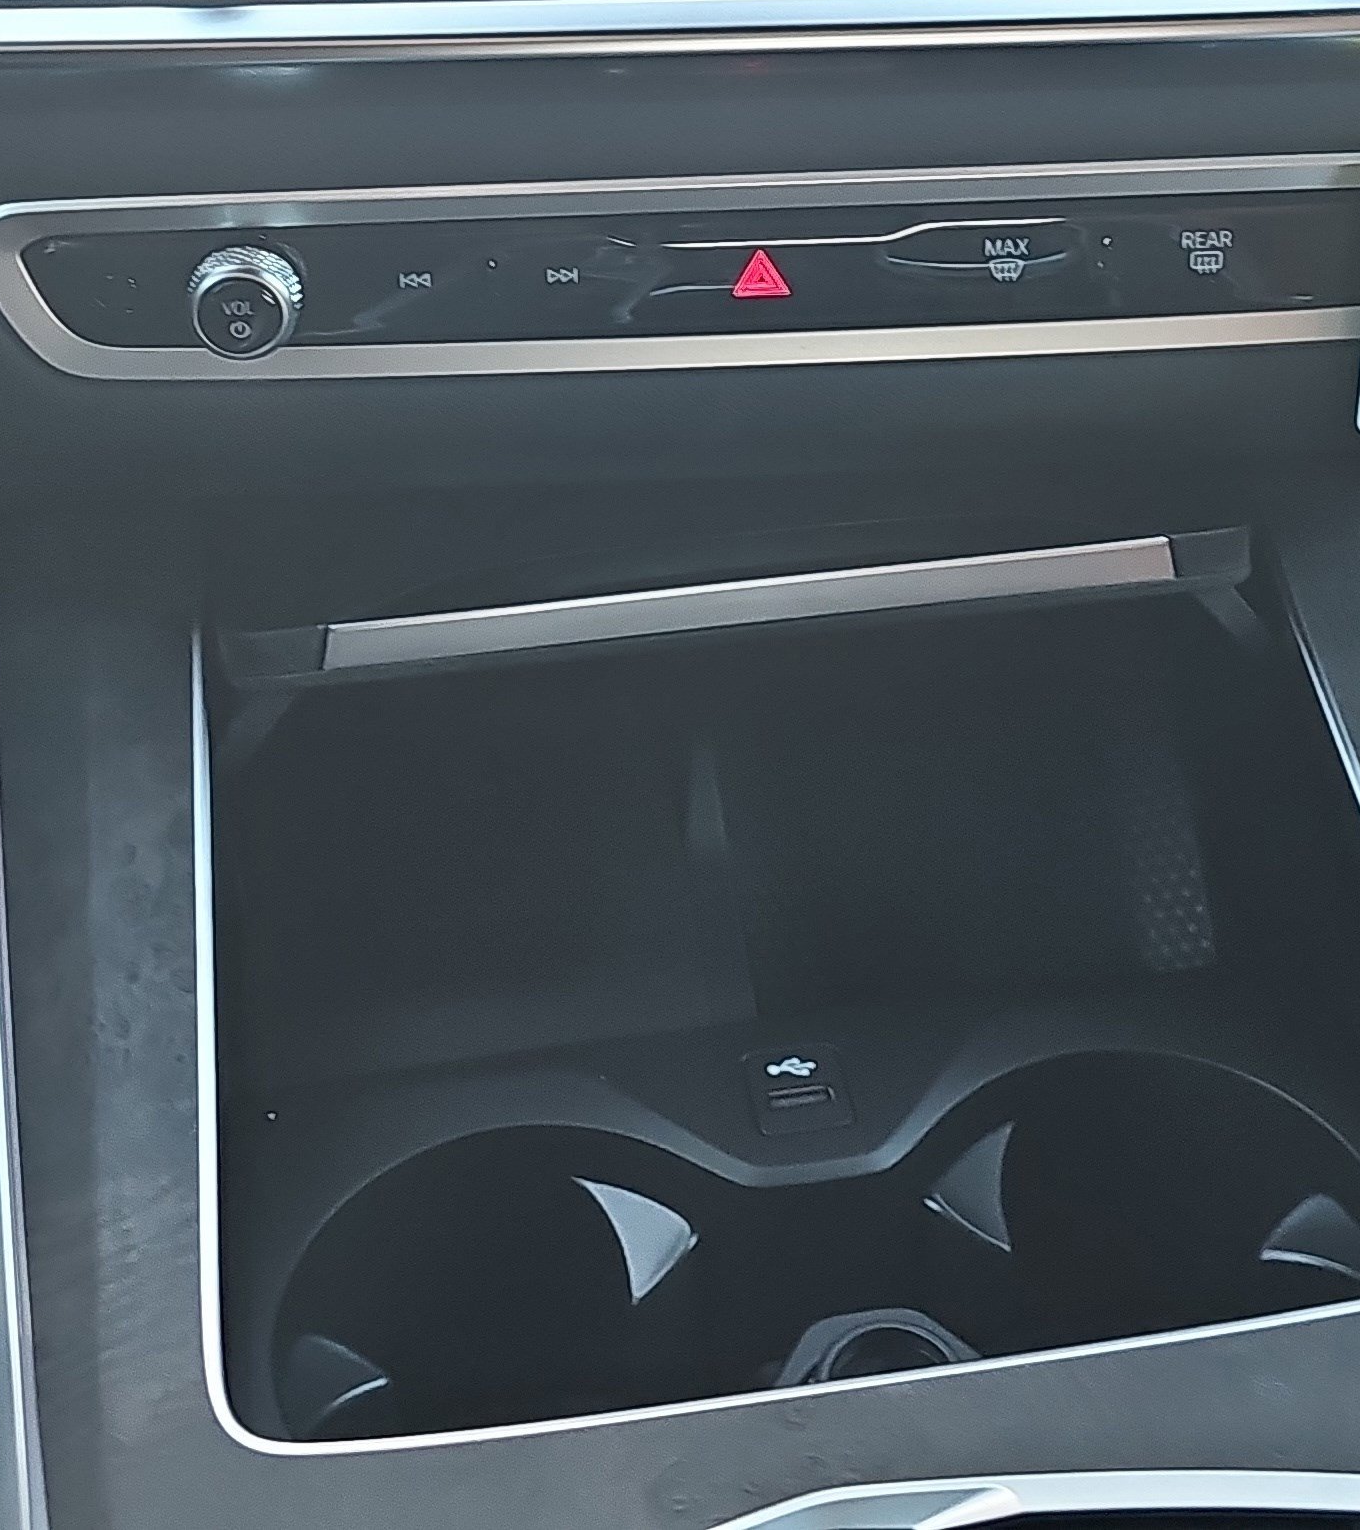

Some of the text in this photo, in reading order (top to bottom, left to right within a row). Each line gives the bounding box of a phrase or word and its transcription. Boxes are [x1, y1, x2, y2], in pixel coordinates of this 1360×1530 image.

[983, 237, 1030, 257] MAX
[1181, 230, 1233, 250] REAR
[221, 300, 254, 317] VOL
